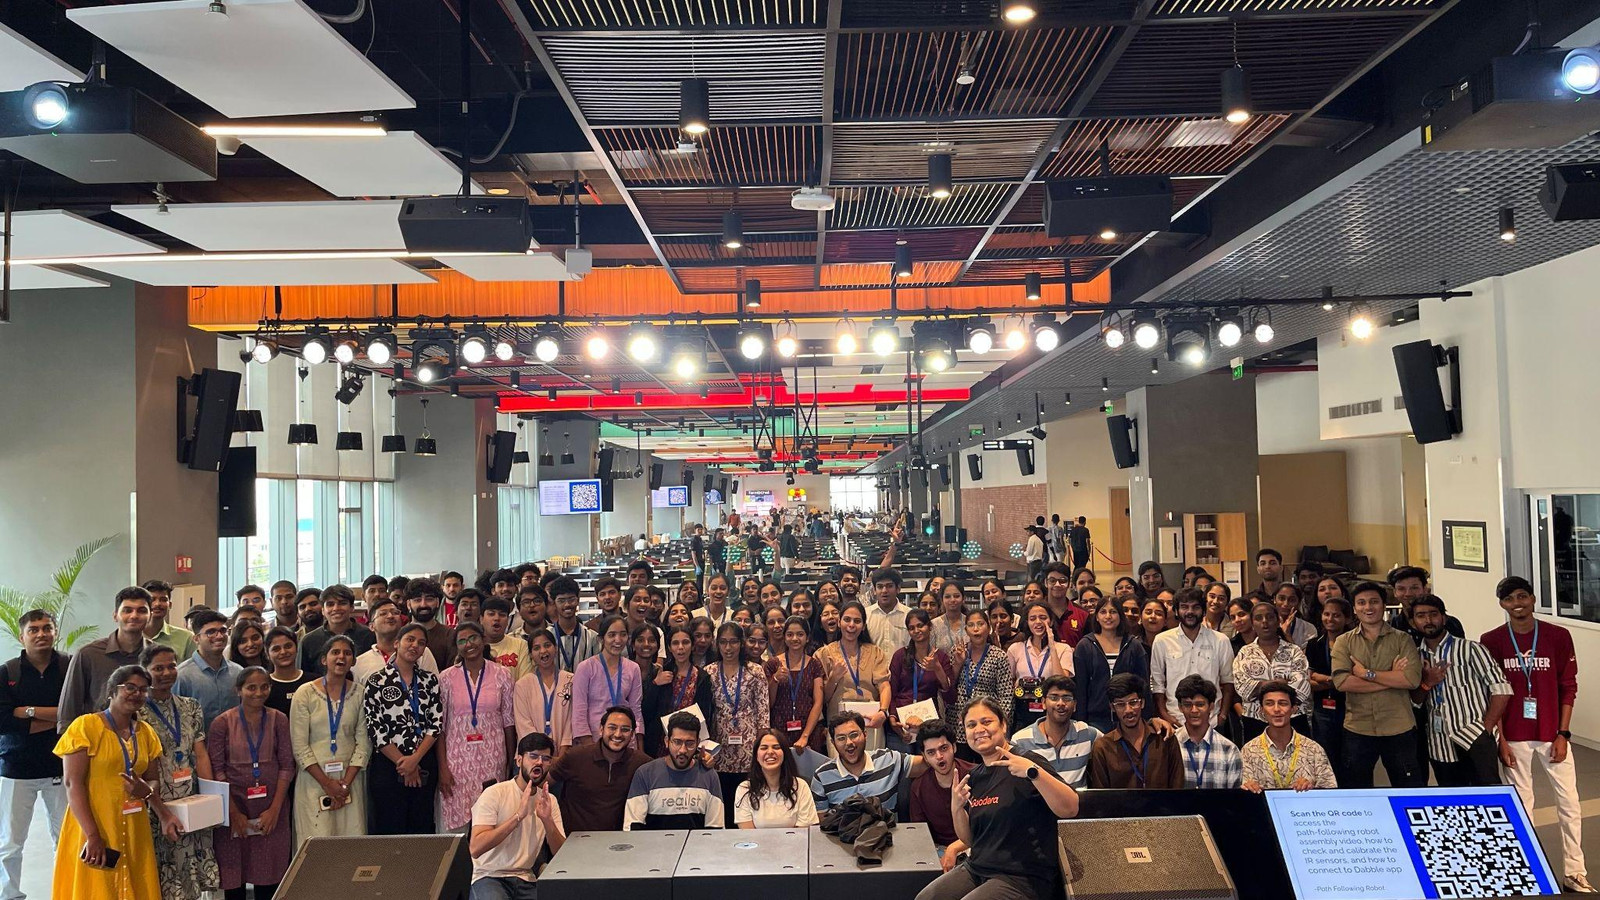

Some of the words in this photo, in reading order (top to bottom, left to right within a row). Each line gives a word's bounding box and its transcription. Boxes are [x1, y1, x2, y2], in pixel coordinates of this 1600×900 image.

[1445, 526, 1450, 535] 2
[1290, 810, 1311, 818] Scan
[1341, 809, 1363, 817] code
[1363, 809, 1373, 817] to
[1296, 828, 1356, 837] path-following
[1357, 828, 1380, 836] robot
[1299, 837, 1338, 846] assembly
[1130, 851, 1147, 859] JBL
[1302, 847, 1327, 855] check
[1346, 846, 1382, 854] calibrate
[1383, 846, 1398, 854] the
[1308, 867, 1342, 875] connect
[1354, 866, 1384, 874] Dabble
[1386, 867, 1403, 875] app
[1333, 885, 1365, 893] Following
